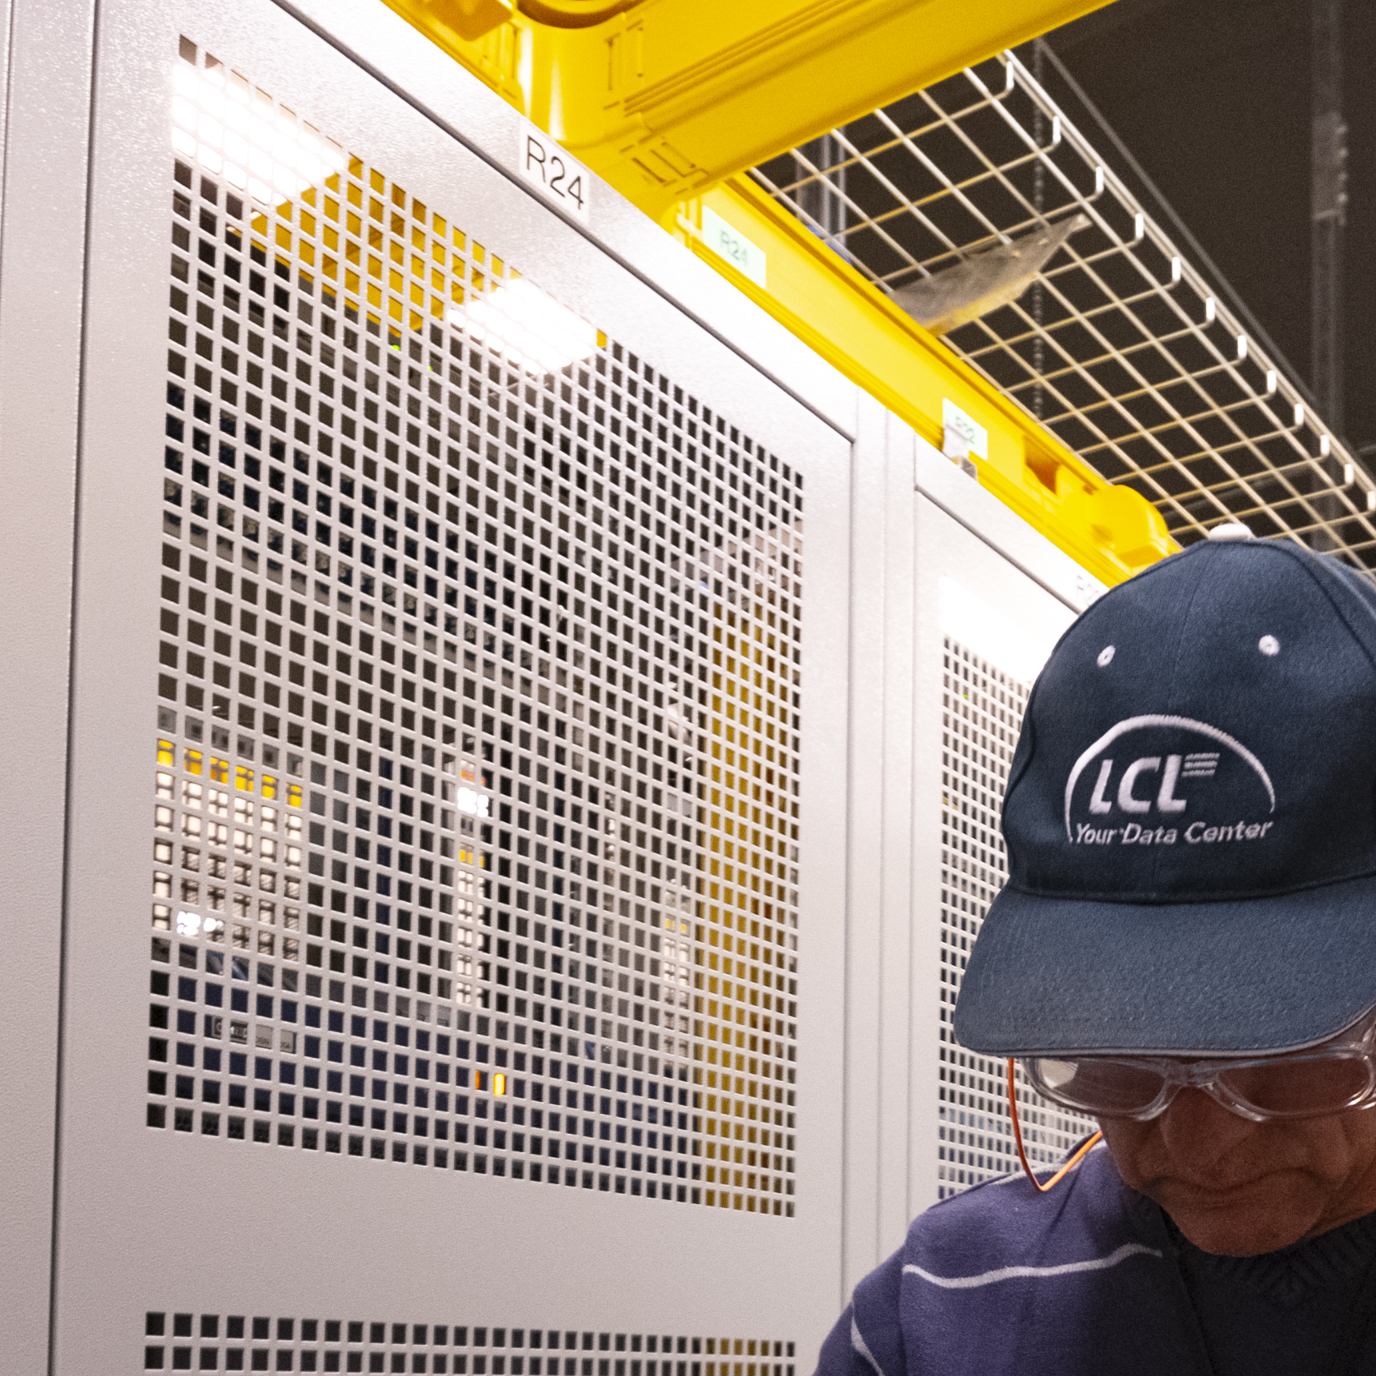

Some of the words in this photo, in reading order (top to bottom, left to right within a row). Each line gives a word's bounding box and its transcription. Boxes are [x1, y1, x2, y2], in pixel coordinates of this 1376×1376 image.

[527, 134, 584, 210] R24
[720, 229, 749, 266] R24
[1089, 754, 1188, 815] LCL
[1076, 822, 1117, 846] Your
[1122, 822, 1178, 846] Data
[1184, 820, 1274, 845] Center
